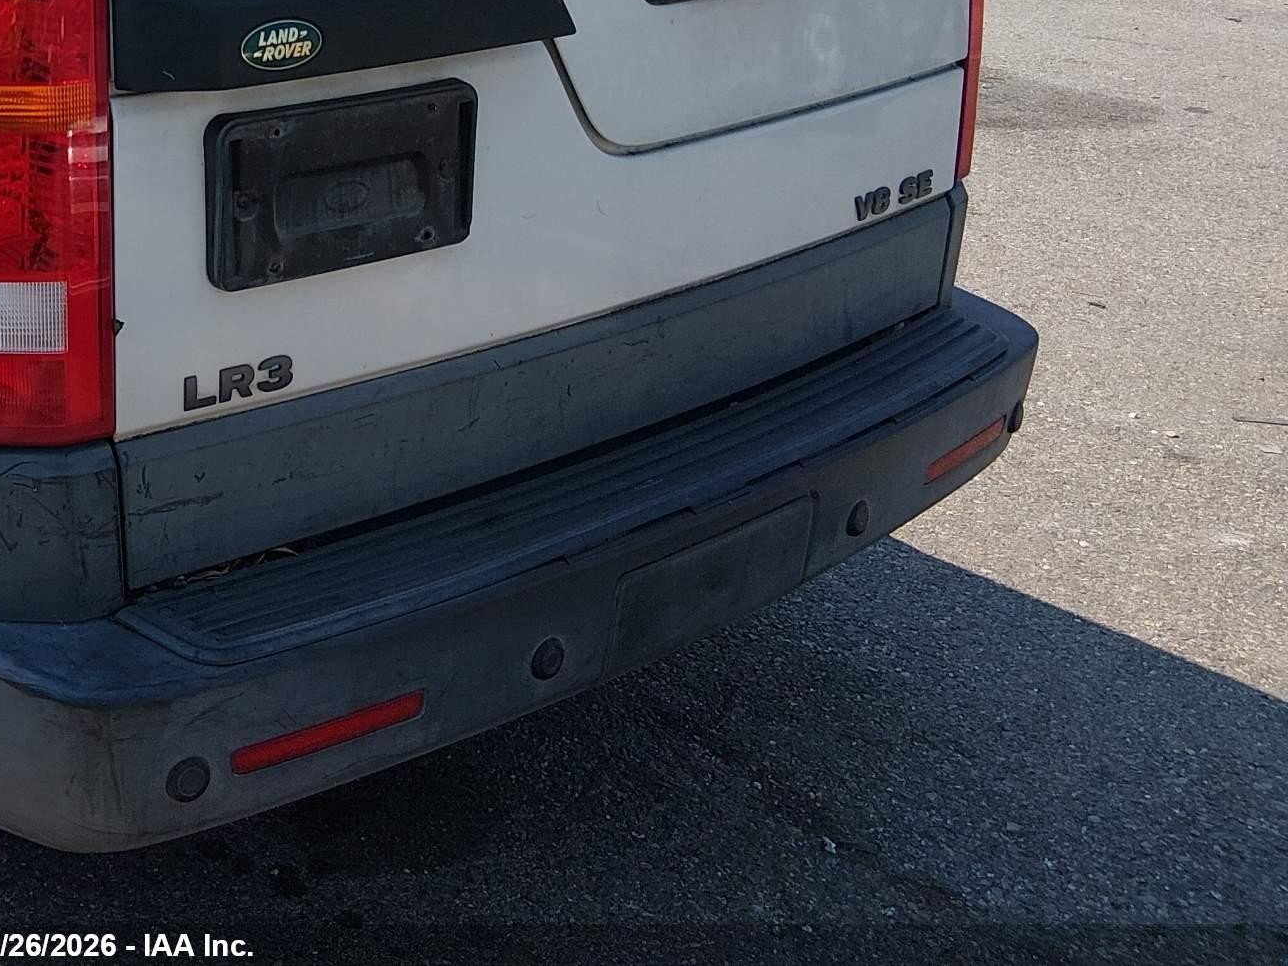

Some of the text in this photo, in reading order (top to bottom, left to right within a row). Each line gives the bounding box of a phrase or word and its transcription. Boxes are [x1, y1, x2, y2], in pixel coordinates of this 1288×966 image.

[258, 27, 299, 47] LAND
[262, 40, 313, 62] ROVER
[898, 169, 934, 204] SE
[183, 354, 294, 412] LR3
